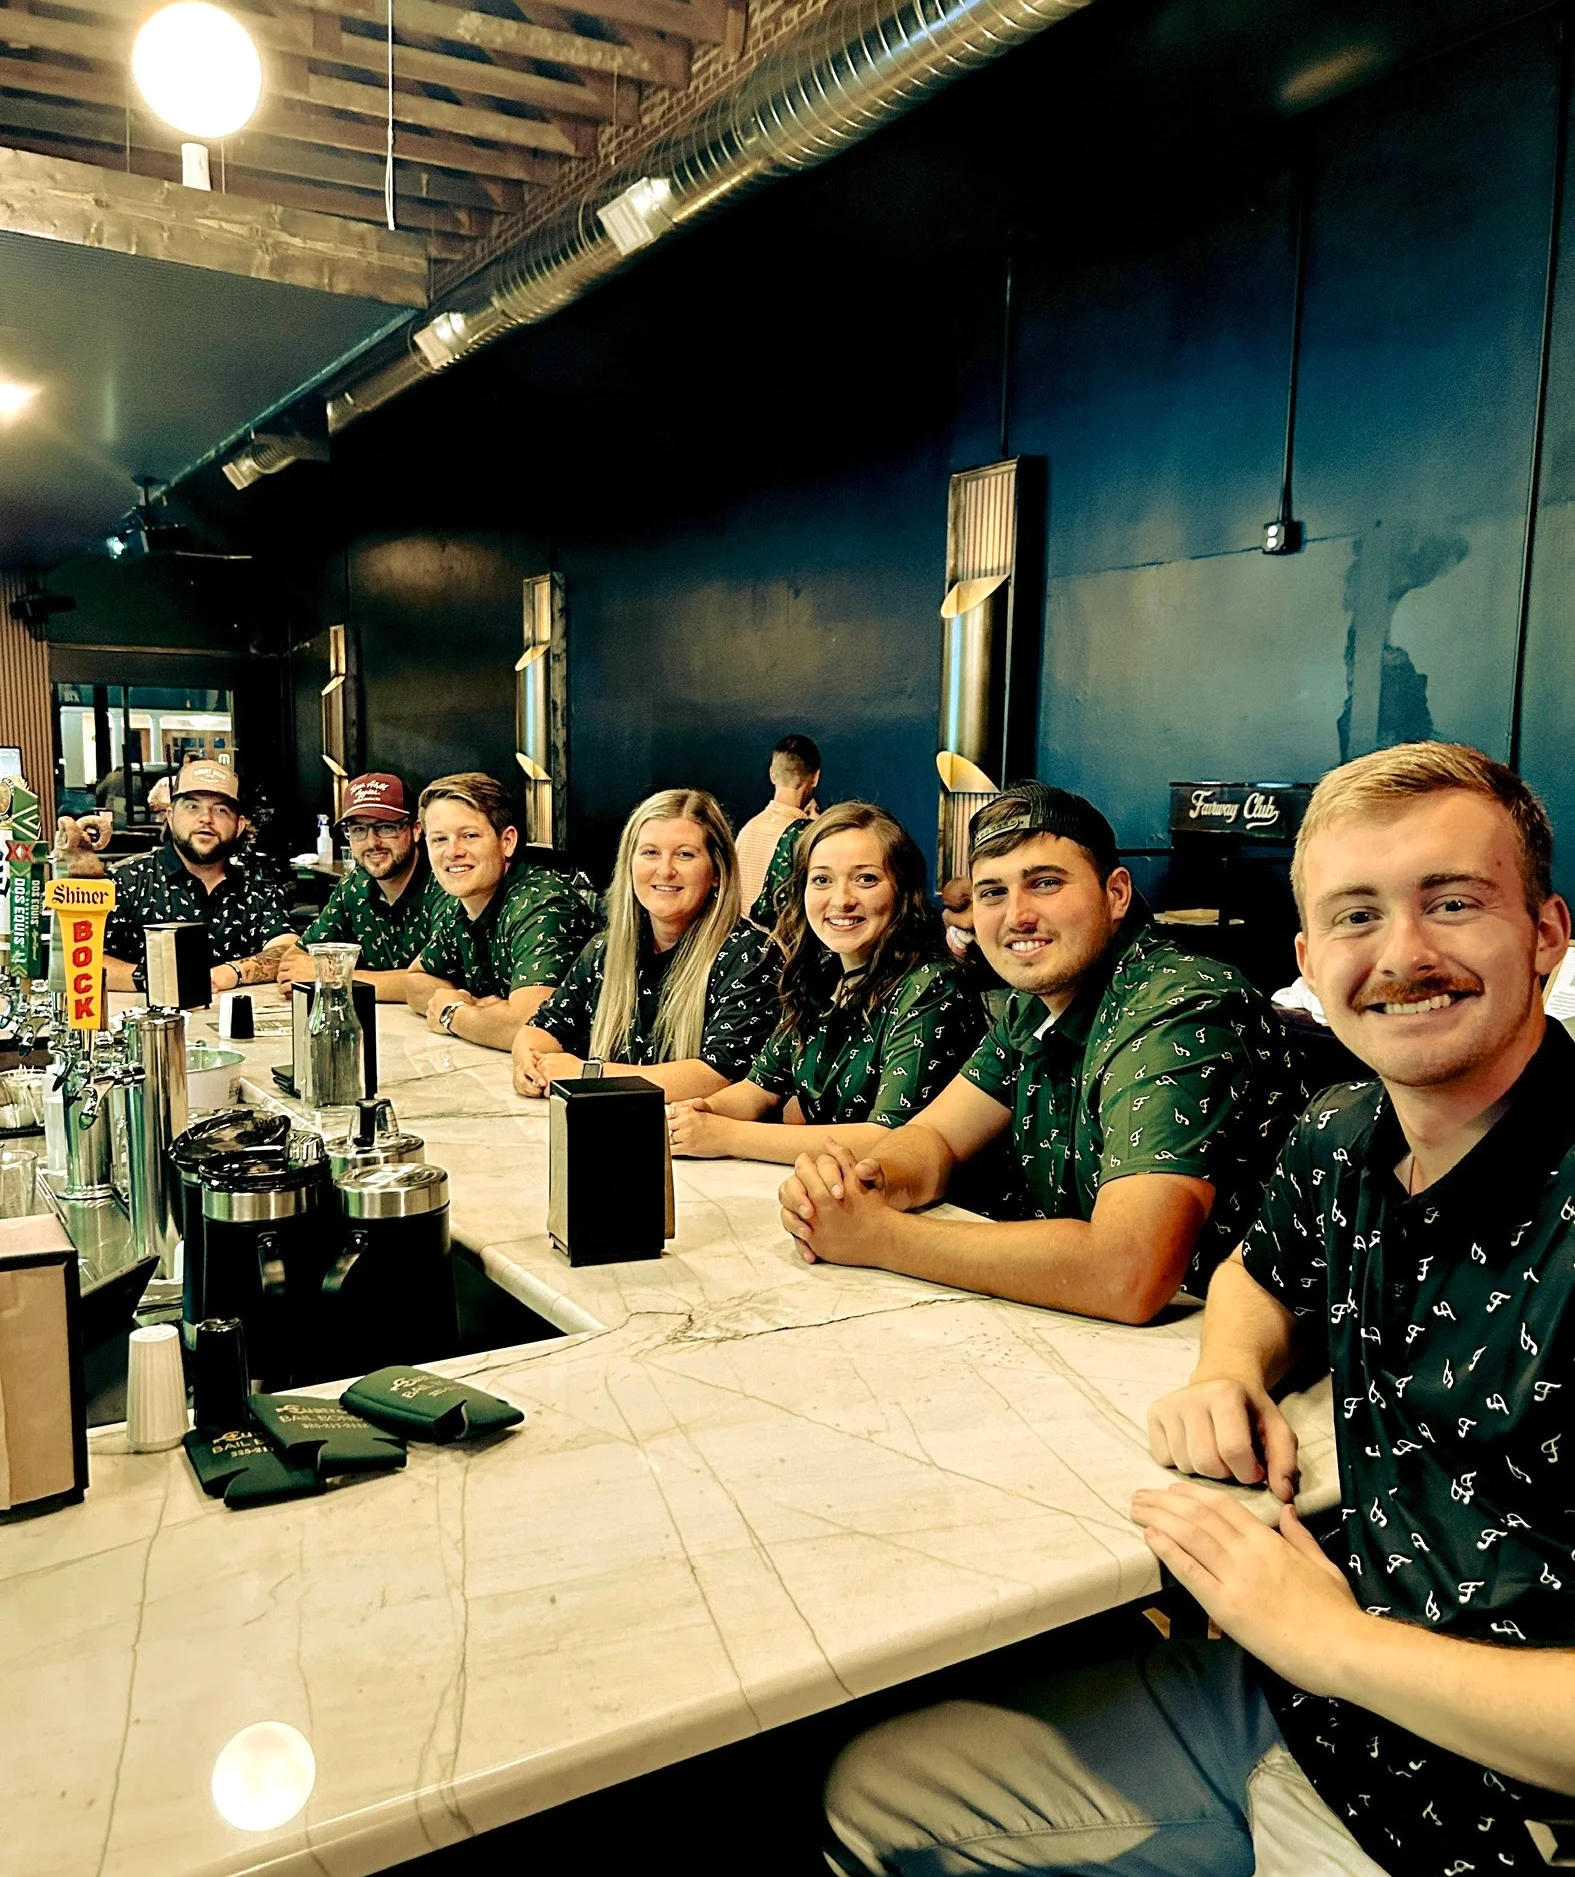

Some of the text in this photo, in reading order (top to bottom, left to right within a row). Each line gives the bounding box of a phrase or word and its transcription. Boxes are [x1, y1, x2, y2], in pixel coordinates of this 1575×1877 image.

[1188, 789, 1280, 830] Fairway Club
[13, 877, 26, 946] DOS EQUIS
[30, 879, 41, 926] DOS EQUIS
[51, 884, 109, 905] Shiner
[72, 920, 95, 1020] BOCK
[212, 1440, 251, 1455] BAIL
